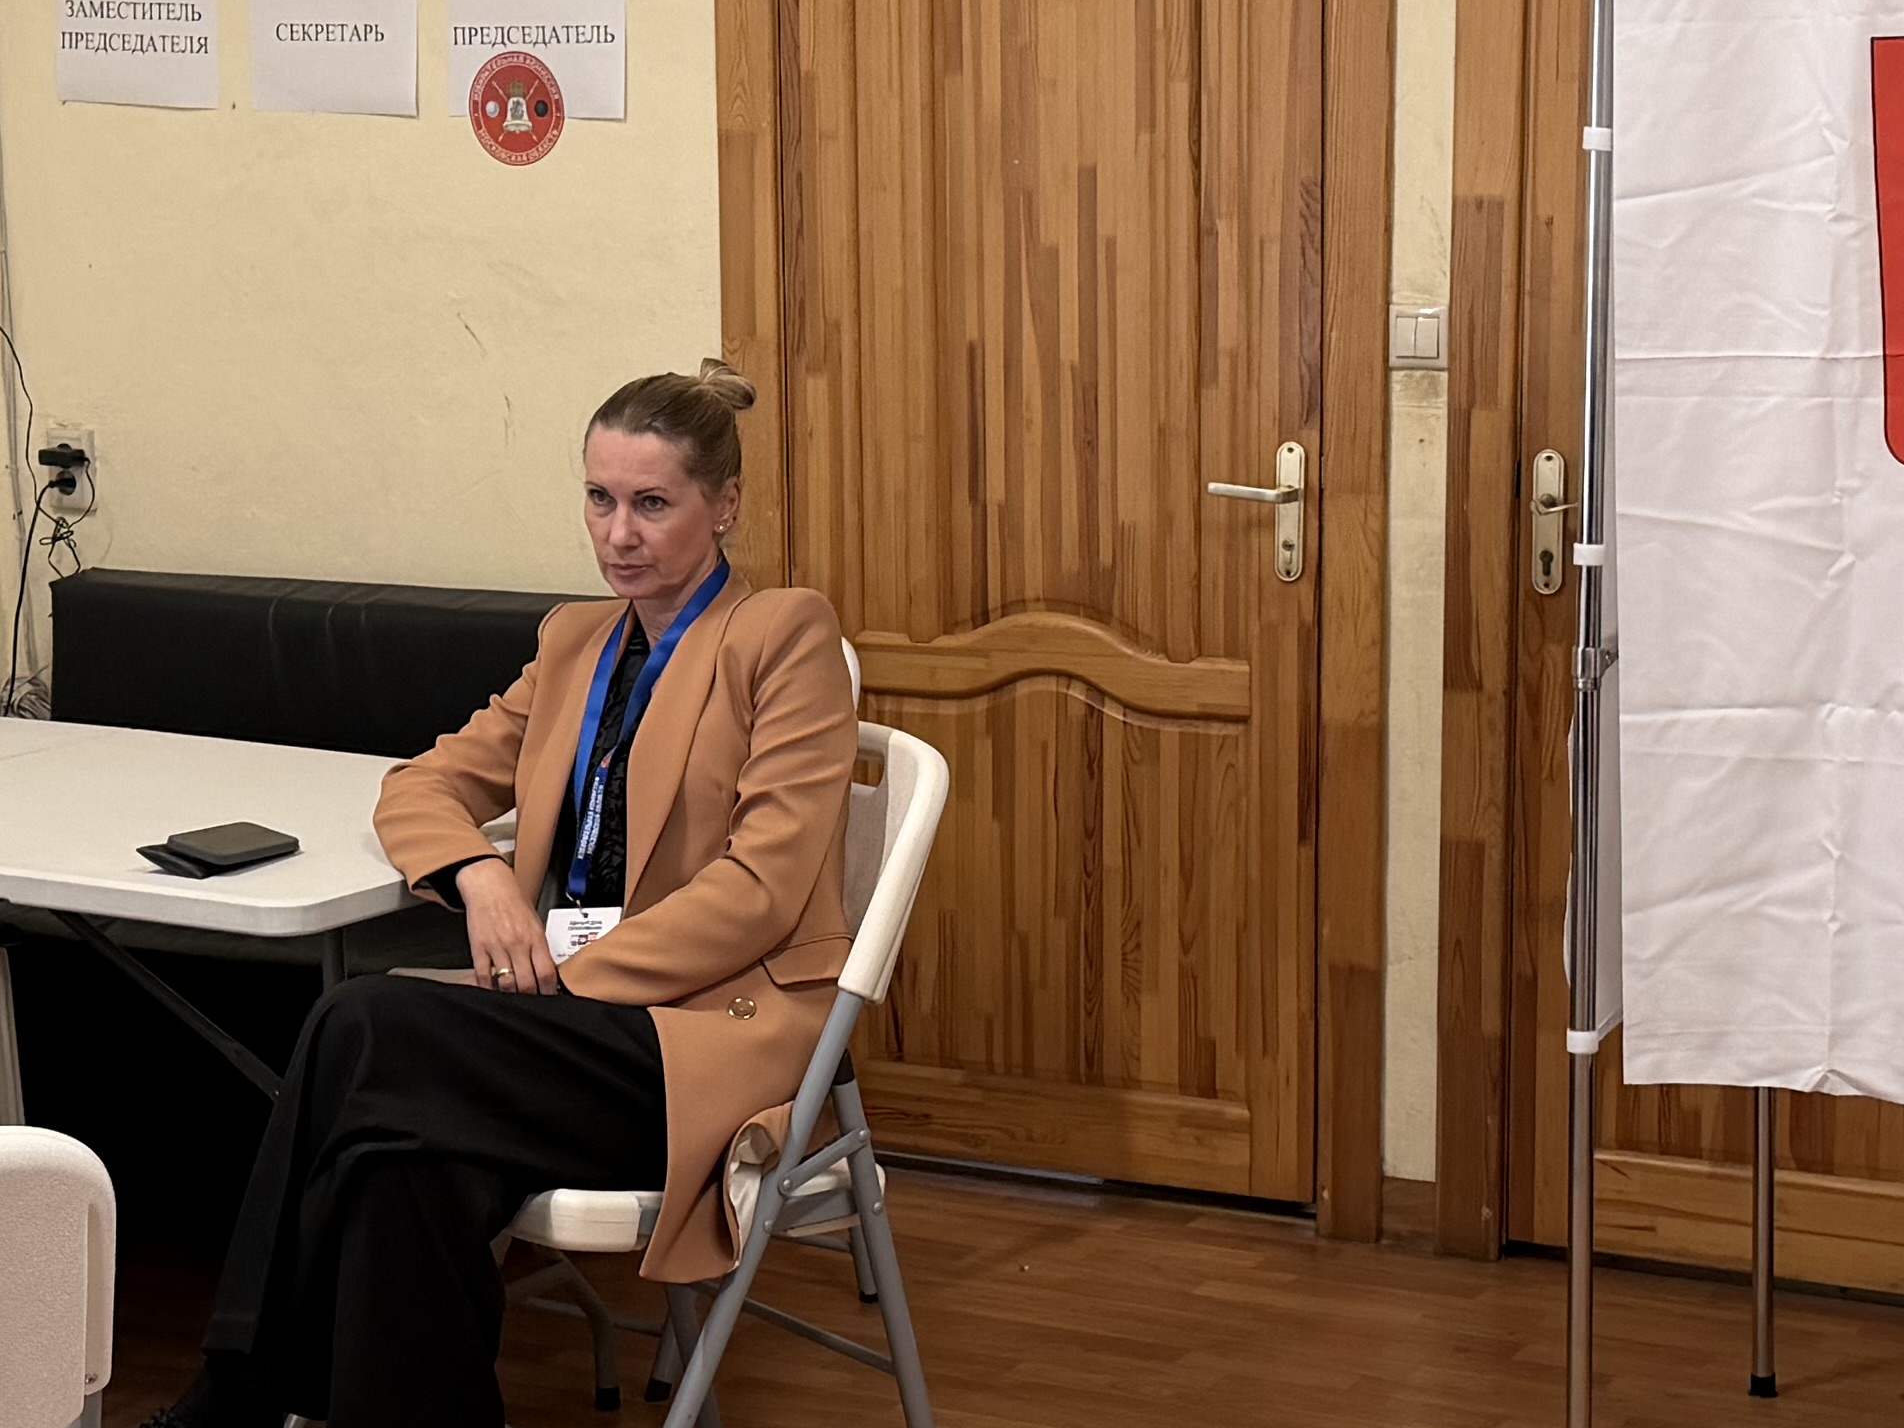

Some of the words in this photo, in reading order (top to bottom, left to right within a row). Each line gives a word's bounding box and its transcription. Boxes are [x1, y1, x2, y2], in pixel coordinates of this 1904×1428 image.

[64, 0, 203, 24] ЗАМЕСТИТЕЛЬ
[60, 30, 210, 55] ПРЕДСЕДАТЕЛЯ
[275, 22, 385, 43] СЕКРЕТАРЬ
[452, 25, 616, 48] ПРЕДСЕДАТЕЛЬ
